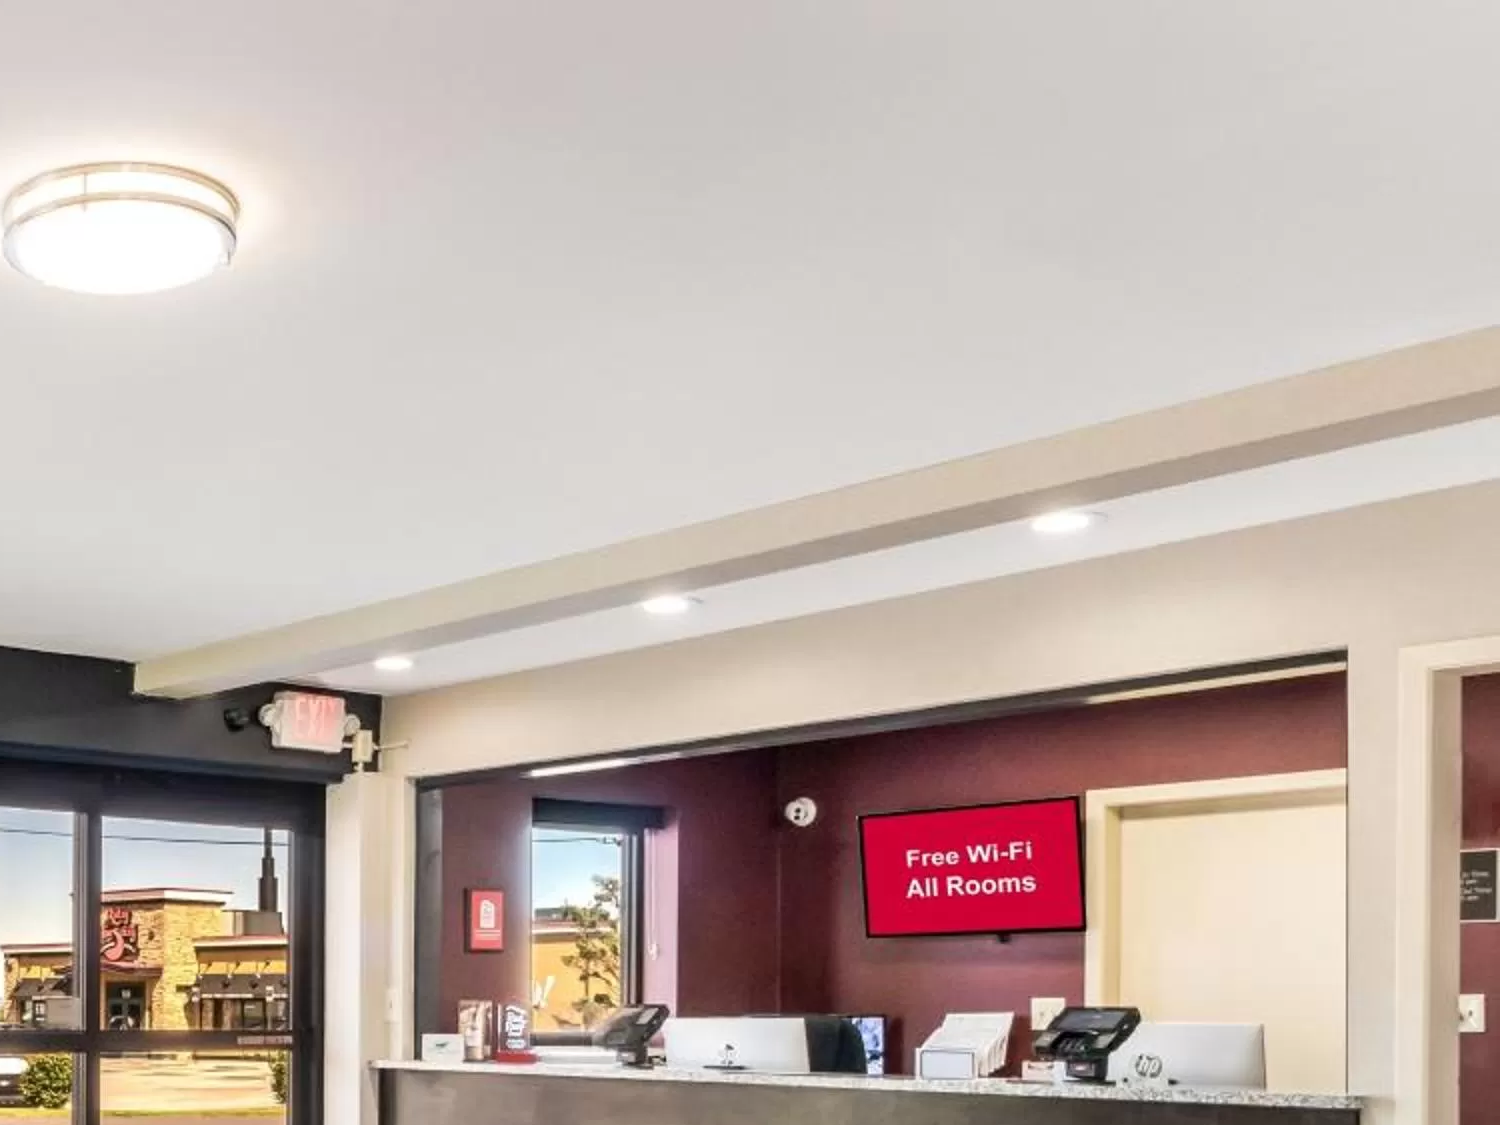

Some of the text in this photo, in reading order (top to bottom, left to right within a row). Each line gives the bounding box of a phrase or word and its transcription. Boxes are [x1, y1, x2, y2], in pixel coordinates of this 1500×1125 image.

[905, 841, 1033, 868] Free Wi-Fi
[905, 873, 1037, 899] All Rooms
